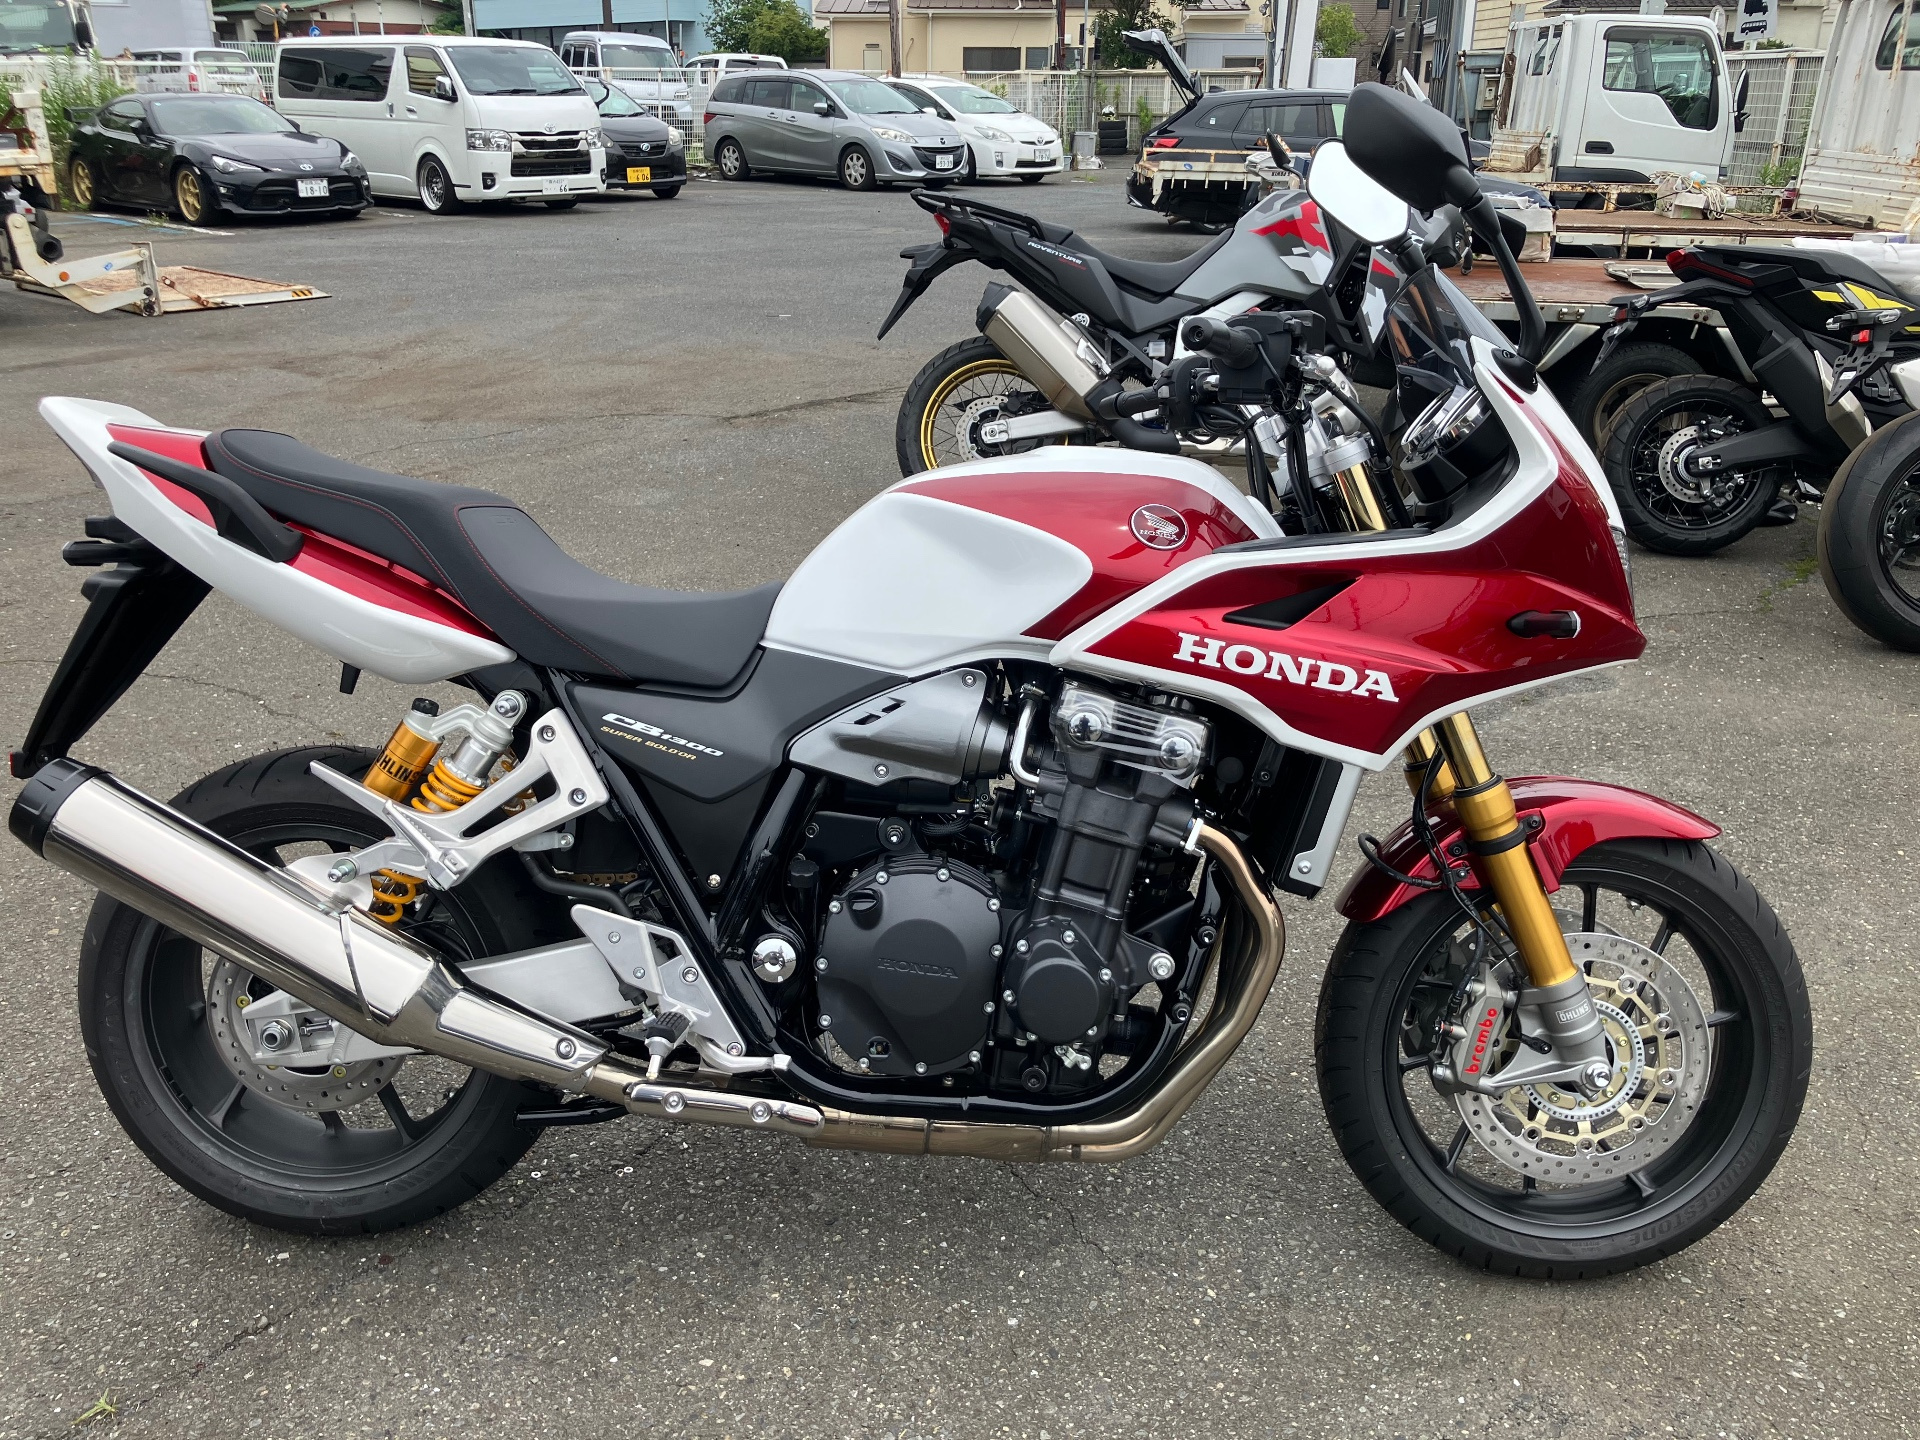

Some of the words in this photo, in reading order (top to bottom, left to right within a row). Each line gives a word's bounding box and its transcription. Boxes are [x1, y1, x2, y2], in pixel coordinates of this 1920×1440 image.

[305, 186, 328, 196] 18-10
[1172, 632, 1400, 703] HONDA
[600, 726, 643, 743] SUPER
[877, 957, 959, 980] HONDA
[1559, 1003, 1589, 1022] ÖHLINS
[1464, 1007, 1498, 1074] brembo
